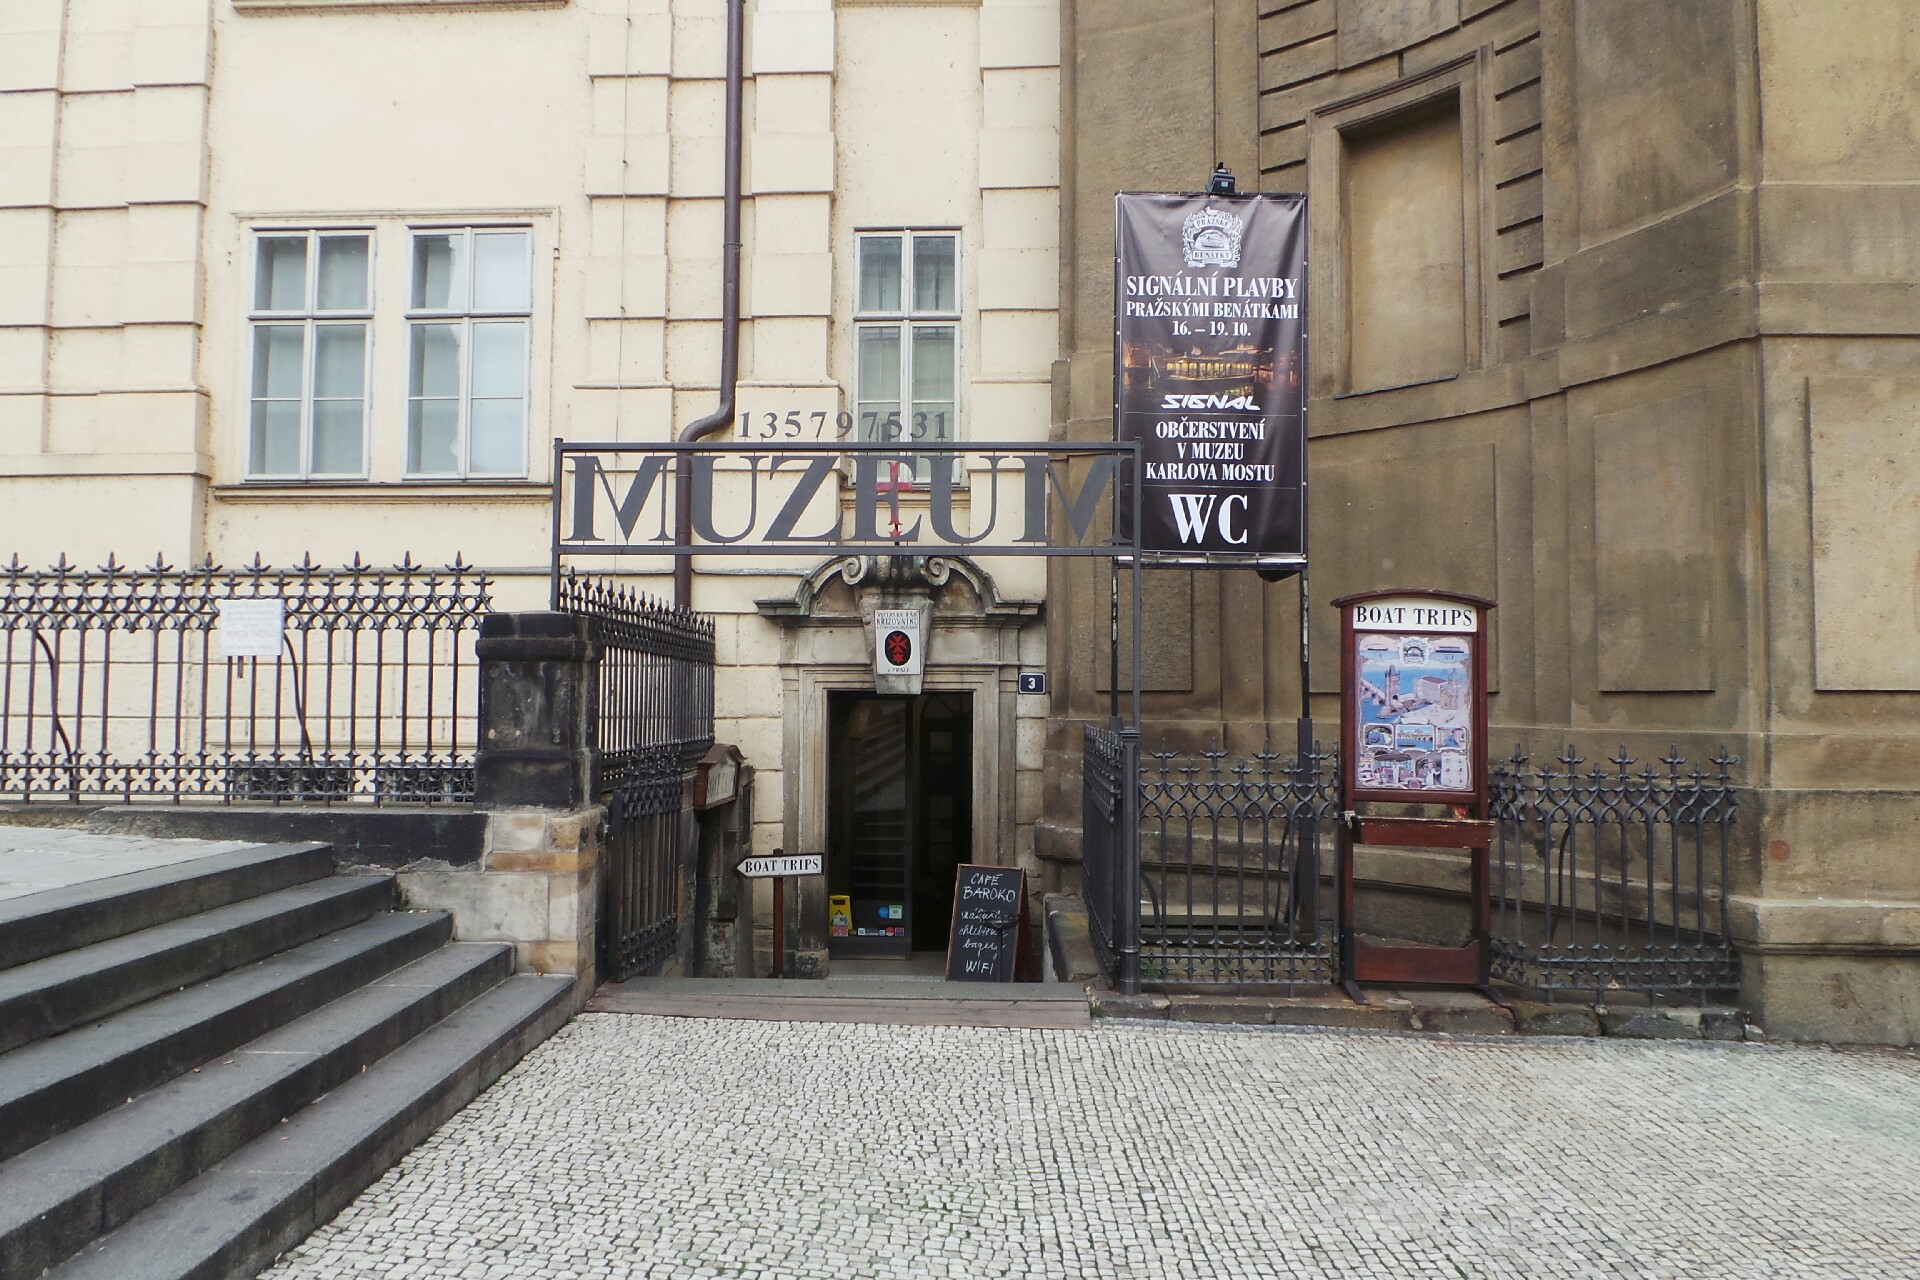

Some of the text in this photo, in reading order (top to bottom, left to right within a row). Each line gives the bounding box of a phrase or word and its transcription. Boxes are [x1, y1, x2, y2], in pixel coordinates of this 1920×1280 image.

[1126, 270, 1298, 299] SIGNÁLNÍ PLAVBY
[1126, 297, 1299, 319] PRAŽSKÝMI BENÁTKAMI
[1172, 320, 1192, 336] 16.
[1209, 321, 1229, 336] 19.
[1232, 322, 1252, 336] 10.
[1161, 394, 1260, 411] SIGNAL
[738, 410, 948, 440] 135797531
[1156, 416, 1266, 440] OBČERSTVENÍ
[1176, 442, 1244, 460] V MUZEU
[1146, 462, 1275, 482] KARLOVA MOSTU
[563, 455, 1133, 544] MUZEUM
[1168, 493, 1248, 545] WC
[1356, 605, 1472, 627] BOAT TRIPS
[1028, 677, 1036, 690] 3
[745, 858, 819, 873] BOAT TRIPS
[970, 873, 1004, 886] CAFÉ
[962, 886, 1016, 902] BAROKO
[965, 959, 994, 976] WIFI
